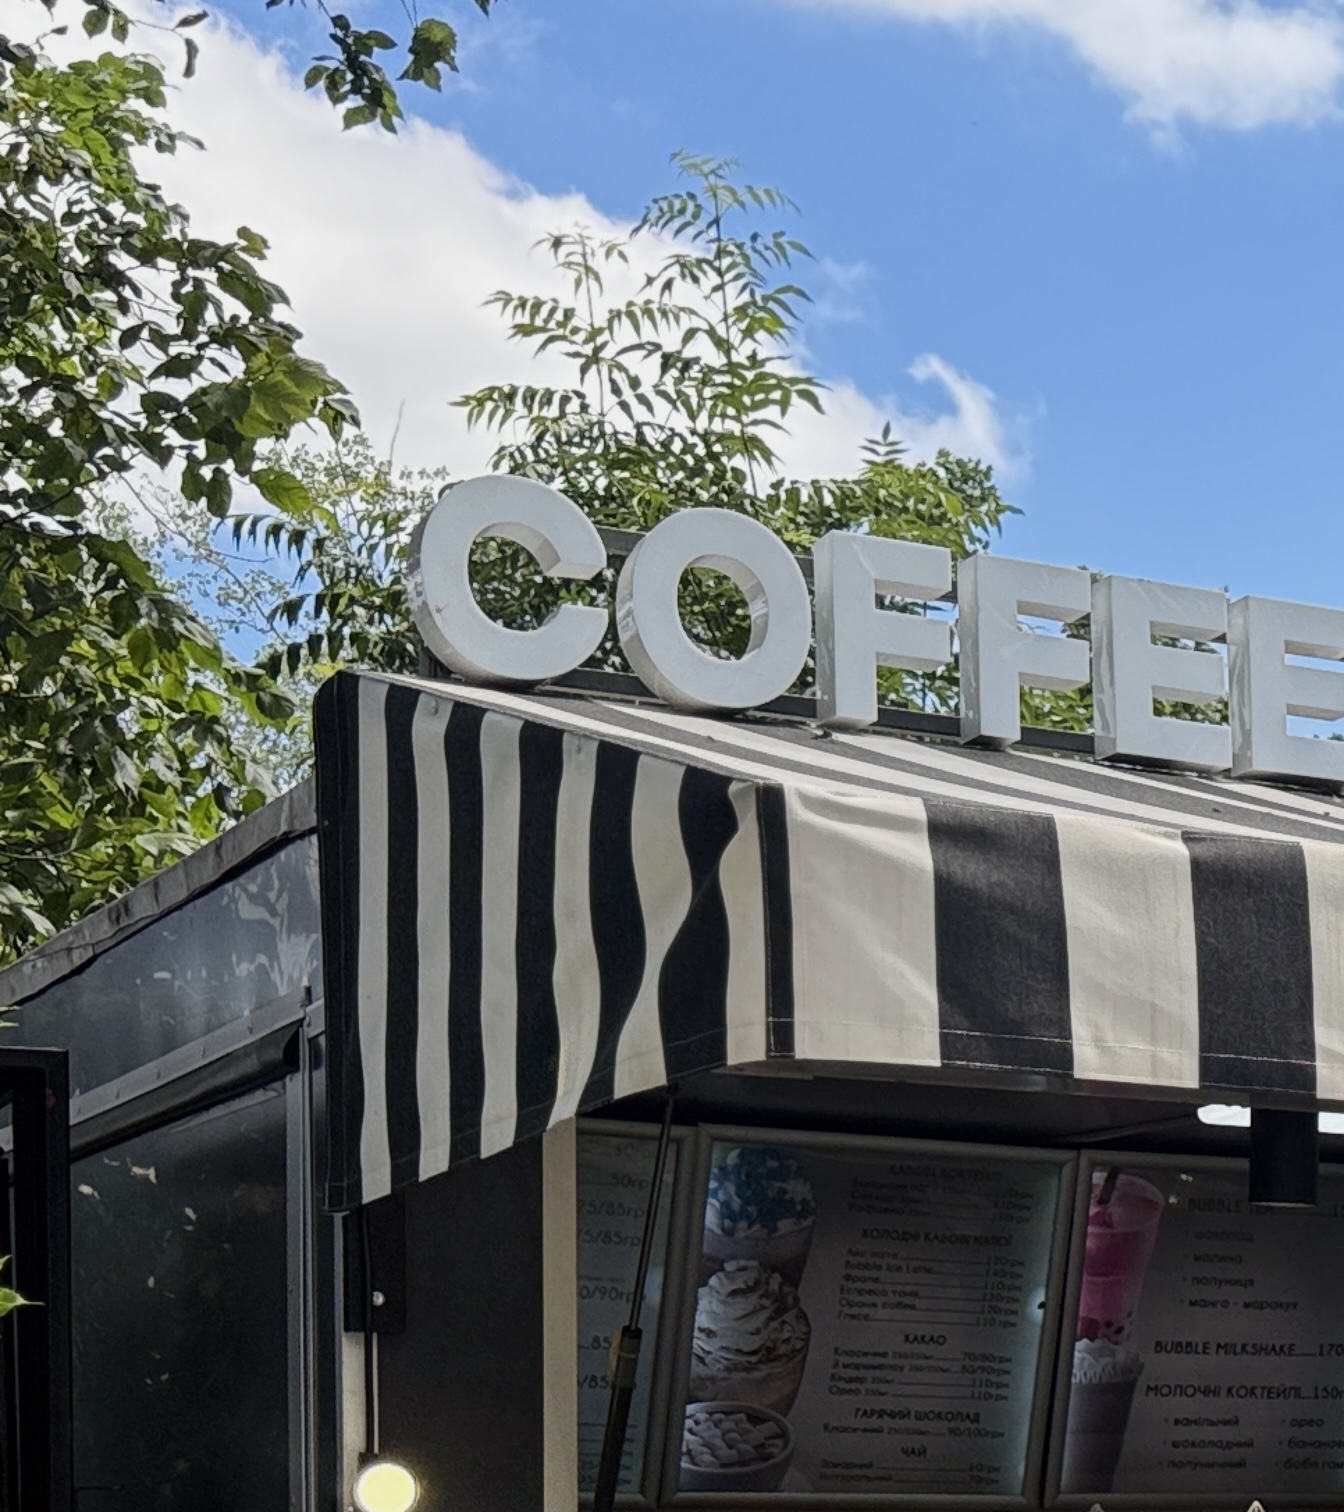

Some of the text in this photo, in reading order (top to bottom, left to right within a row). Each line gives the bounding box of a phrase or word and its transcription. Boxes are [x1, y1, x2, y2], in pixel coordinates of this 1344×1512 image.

[904, 1333, 948, 1346] КАКАО
[1153, 1340, 1211, 1356] BUBBLE
[1215, 1340, 1297, 1357] MILKSHAKE
[1145, 1383, 1221, 1398] МОЛОЧНІ
[1226, 1382, 1302, 1400] КОКТЕЙЛІ
[914, 1409, 981, 1424] ШОКОЛАД
[901, 1444, 927, 1459] ЧАЙ
